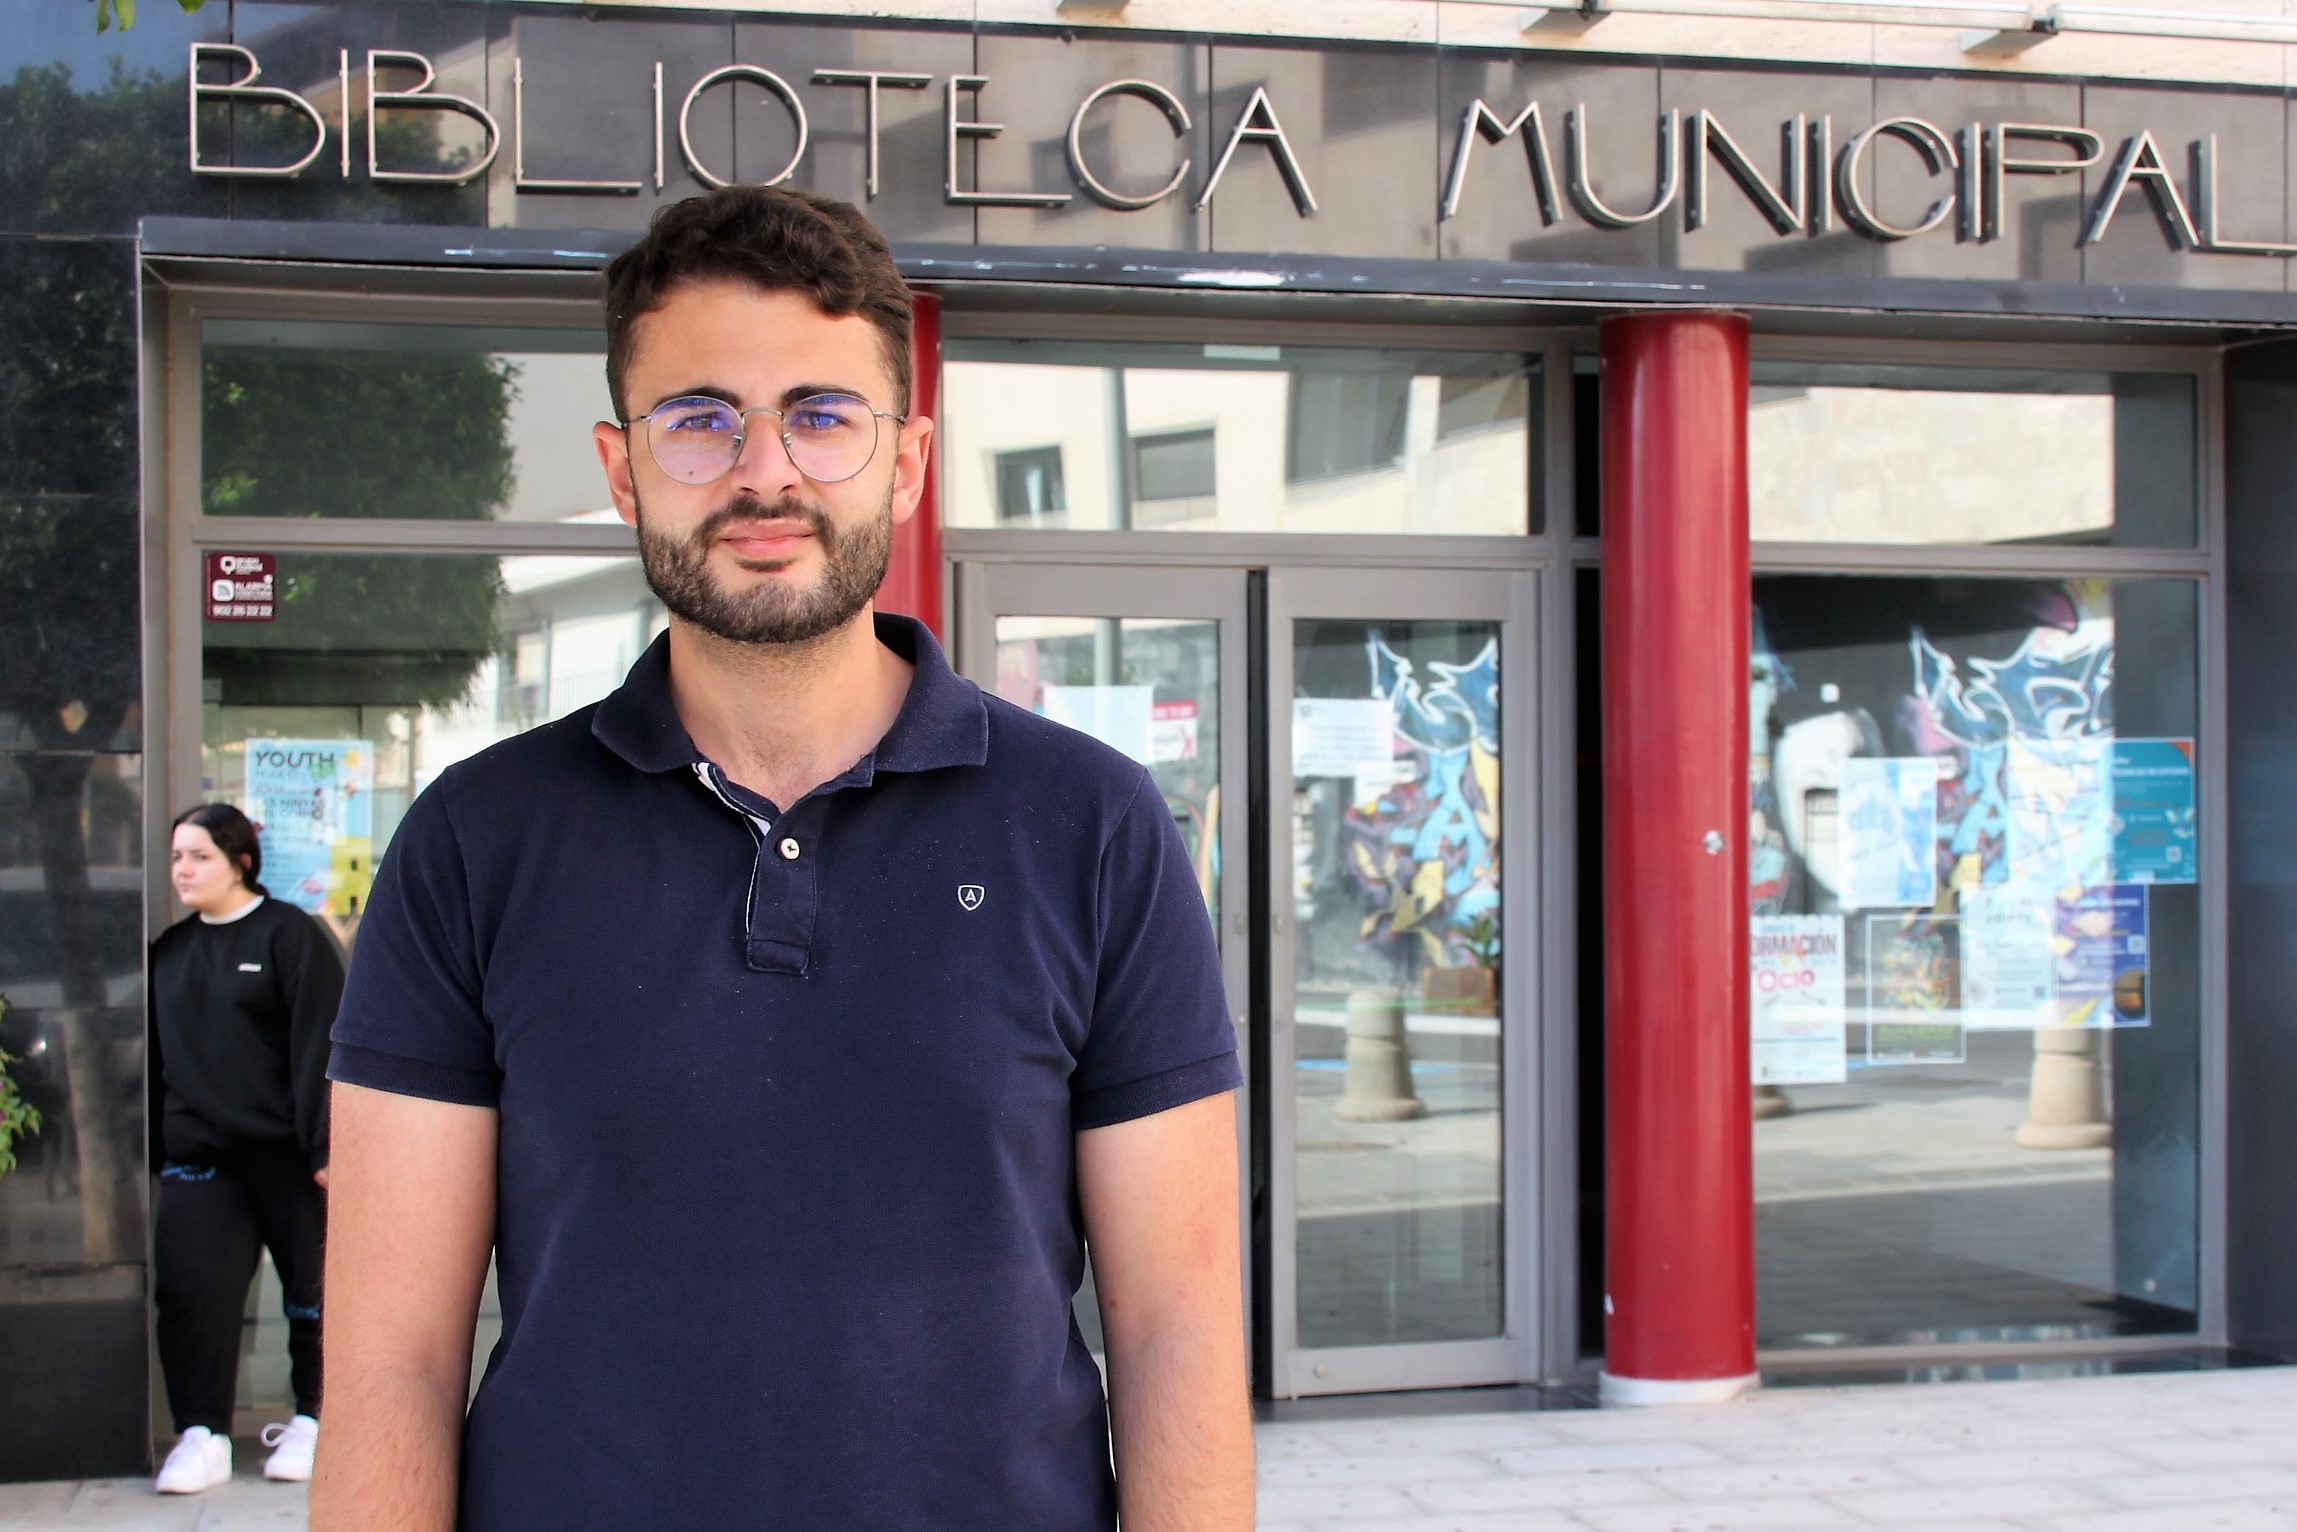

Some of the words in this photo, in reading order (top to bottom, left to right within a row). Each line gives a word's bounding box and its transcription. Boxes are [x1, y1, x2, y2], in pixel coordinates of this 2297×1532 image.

[189, 42, 1320, 218] BIBLIOTECA
[1442, 98, 2297, 255] MUNICIPAL
[255, 751, 335, 768] YOUTH
[965, 888, 977, 902] A
